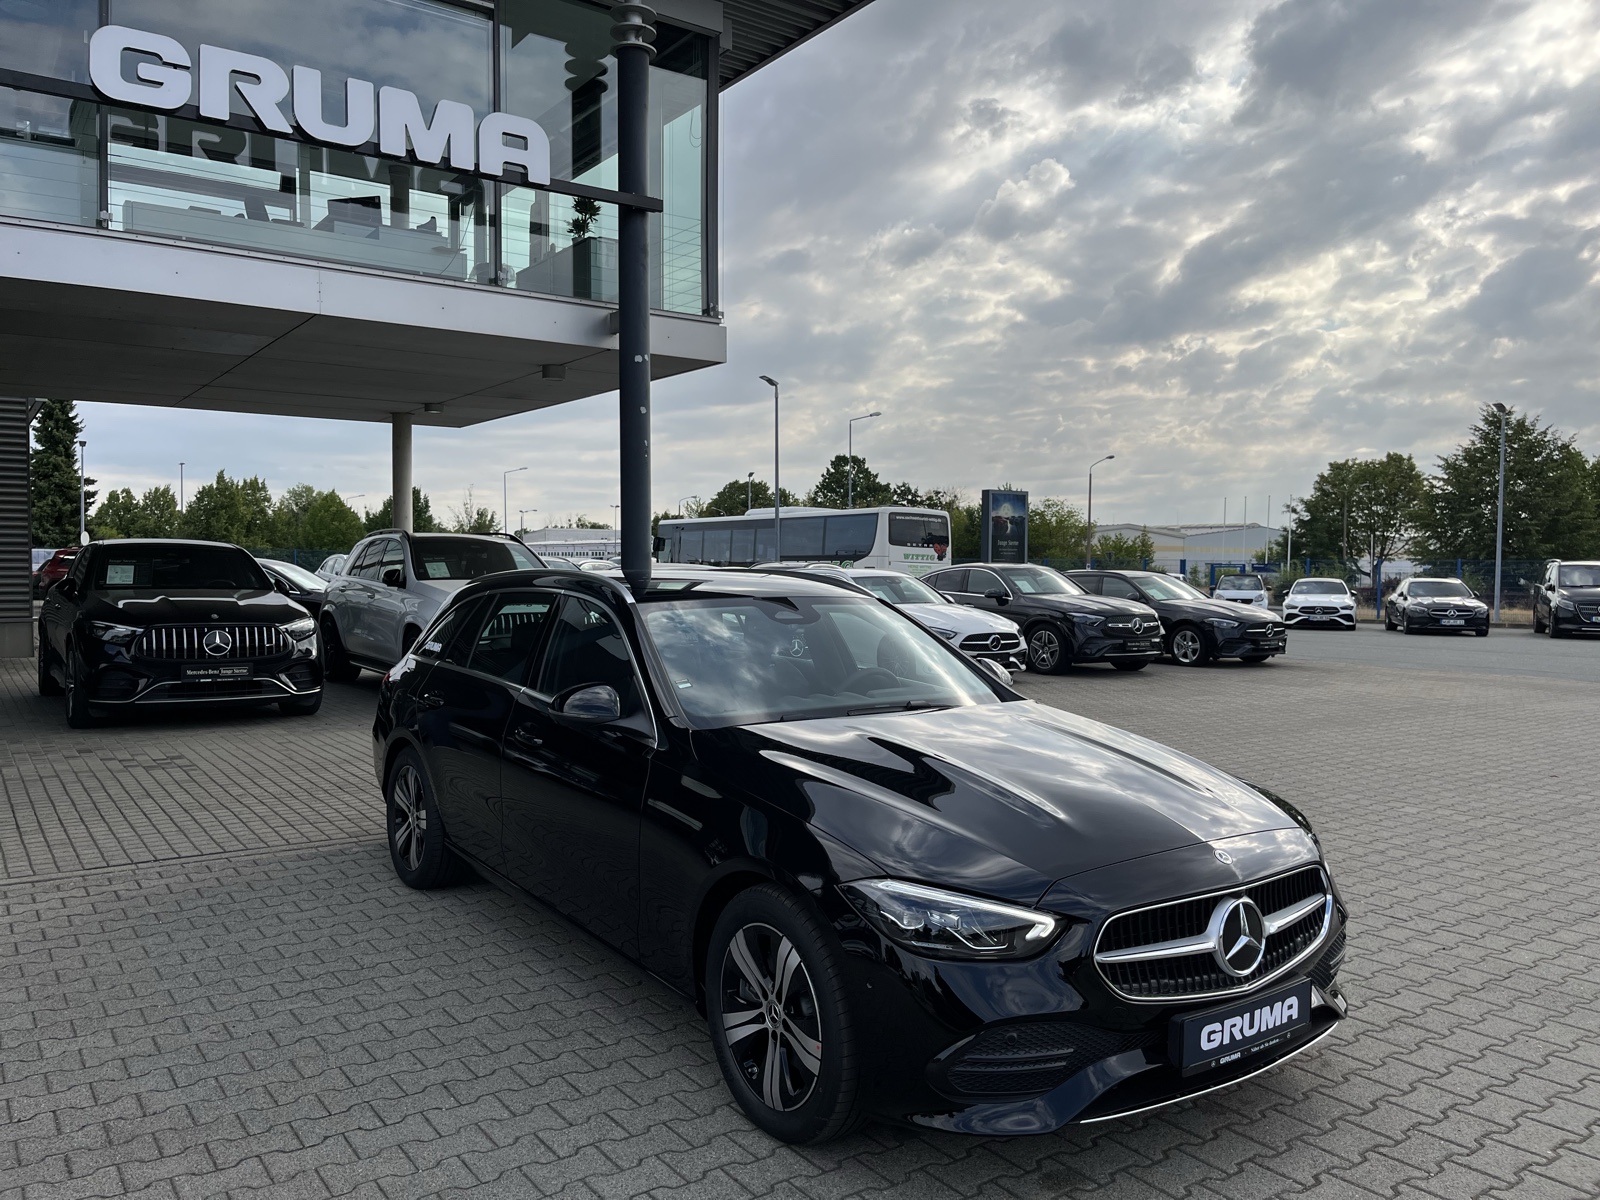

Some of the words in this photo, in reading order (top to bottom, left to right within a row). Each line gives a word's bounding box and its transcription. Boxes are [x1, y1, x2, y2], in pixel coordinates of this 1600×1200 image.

[89, 25, 551, 185] GRUMA
[903, 553, 936, 561] WITTIG
[1200, 995, 1299, 1051] GRUMA
[1219, 1052, 1241, 1065] GRUMA
